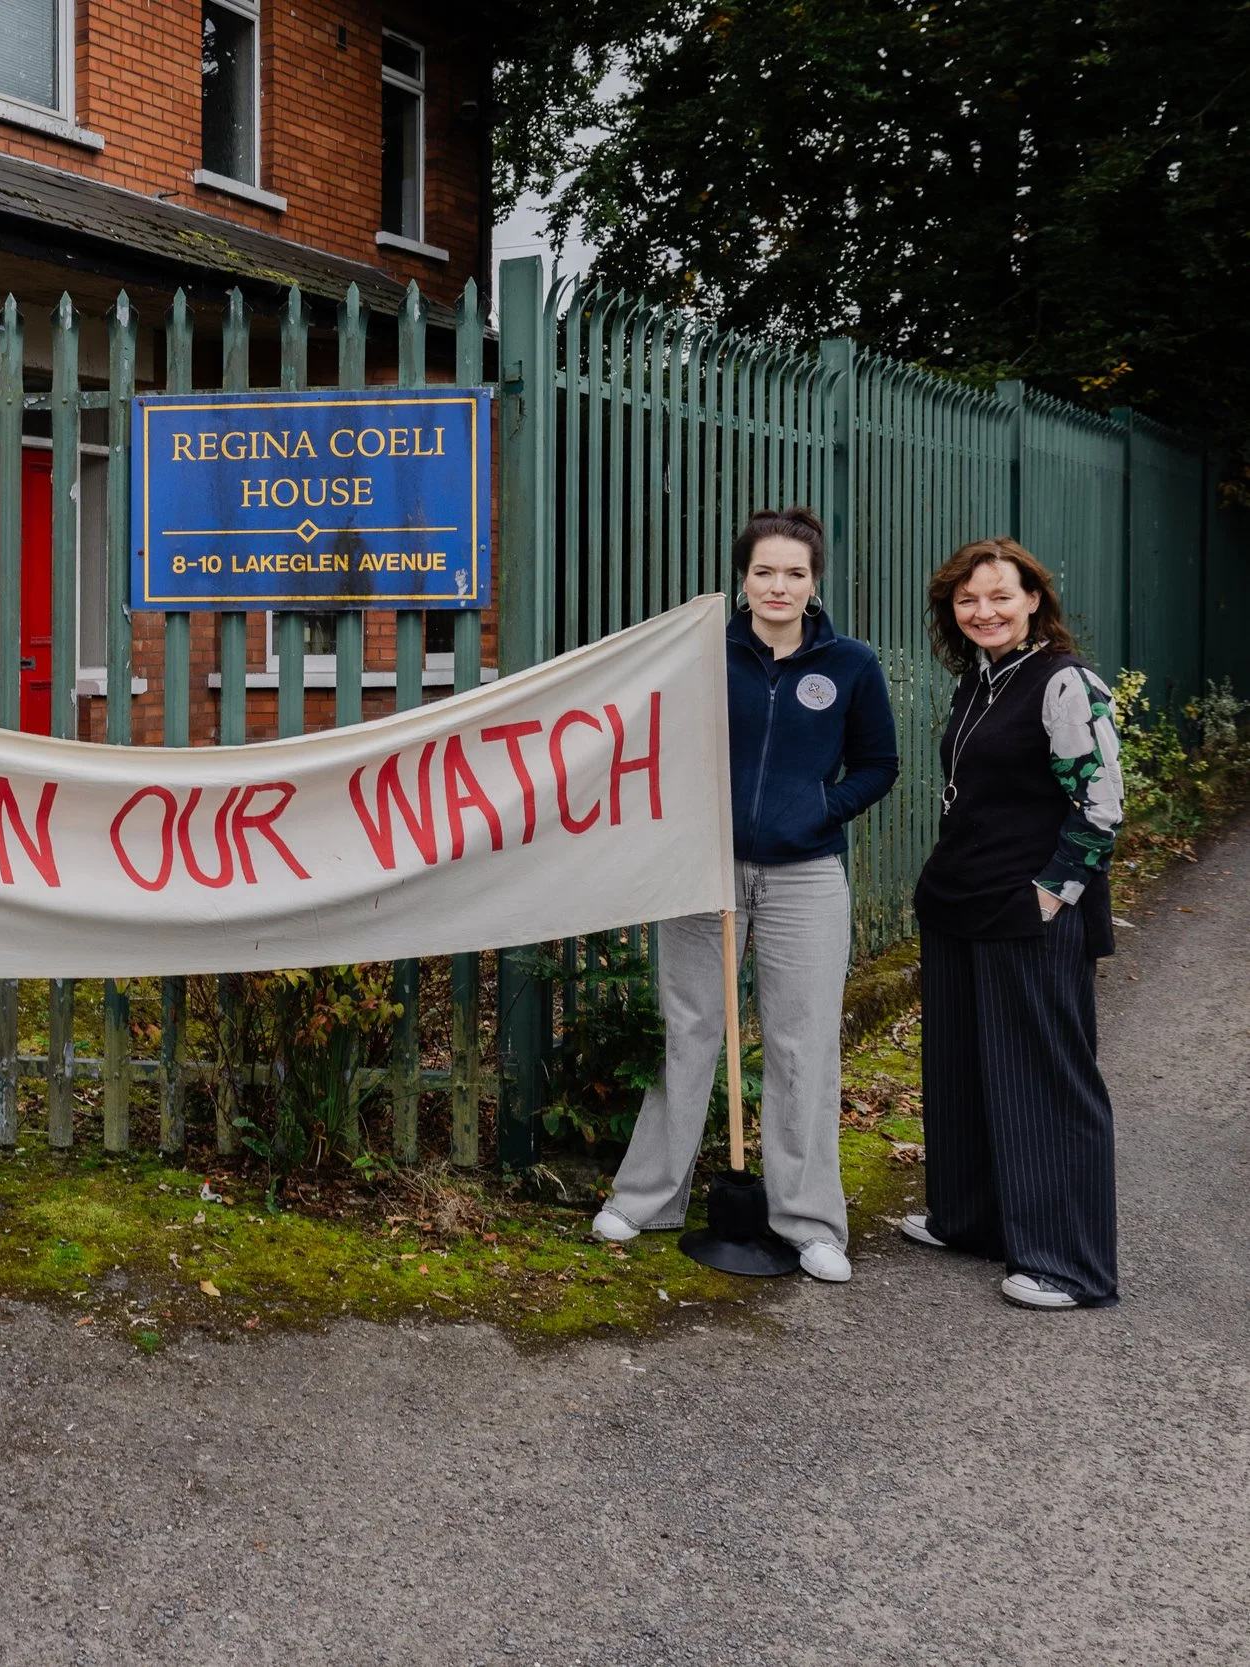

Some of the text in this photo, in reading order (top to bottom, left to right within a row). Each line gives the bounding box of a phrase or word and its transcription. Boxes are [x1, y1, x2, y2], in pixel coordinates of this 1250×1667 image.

[172, 427, 446, 461] REGINA COELI
[240, 477, 374, 507] HOUSE
[172, 552, 447, 574] 8-10 LAKEGLEN AVENUE
[110, 780, 312, 892] OUR
[349, 691, 663, 871] WATCH
